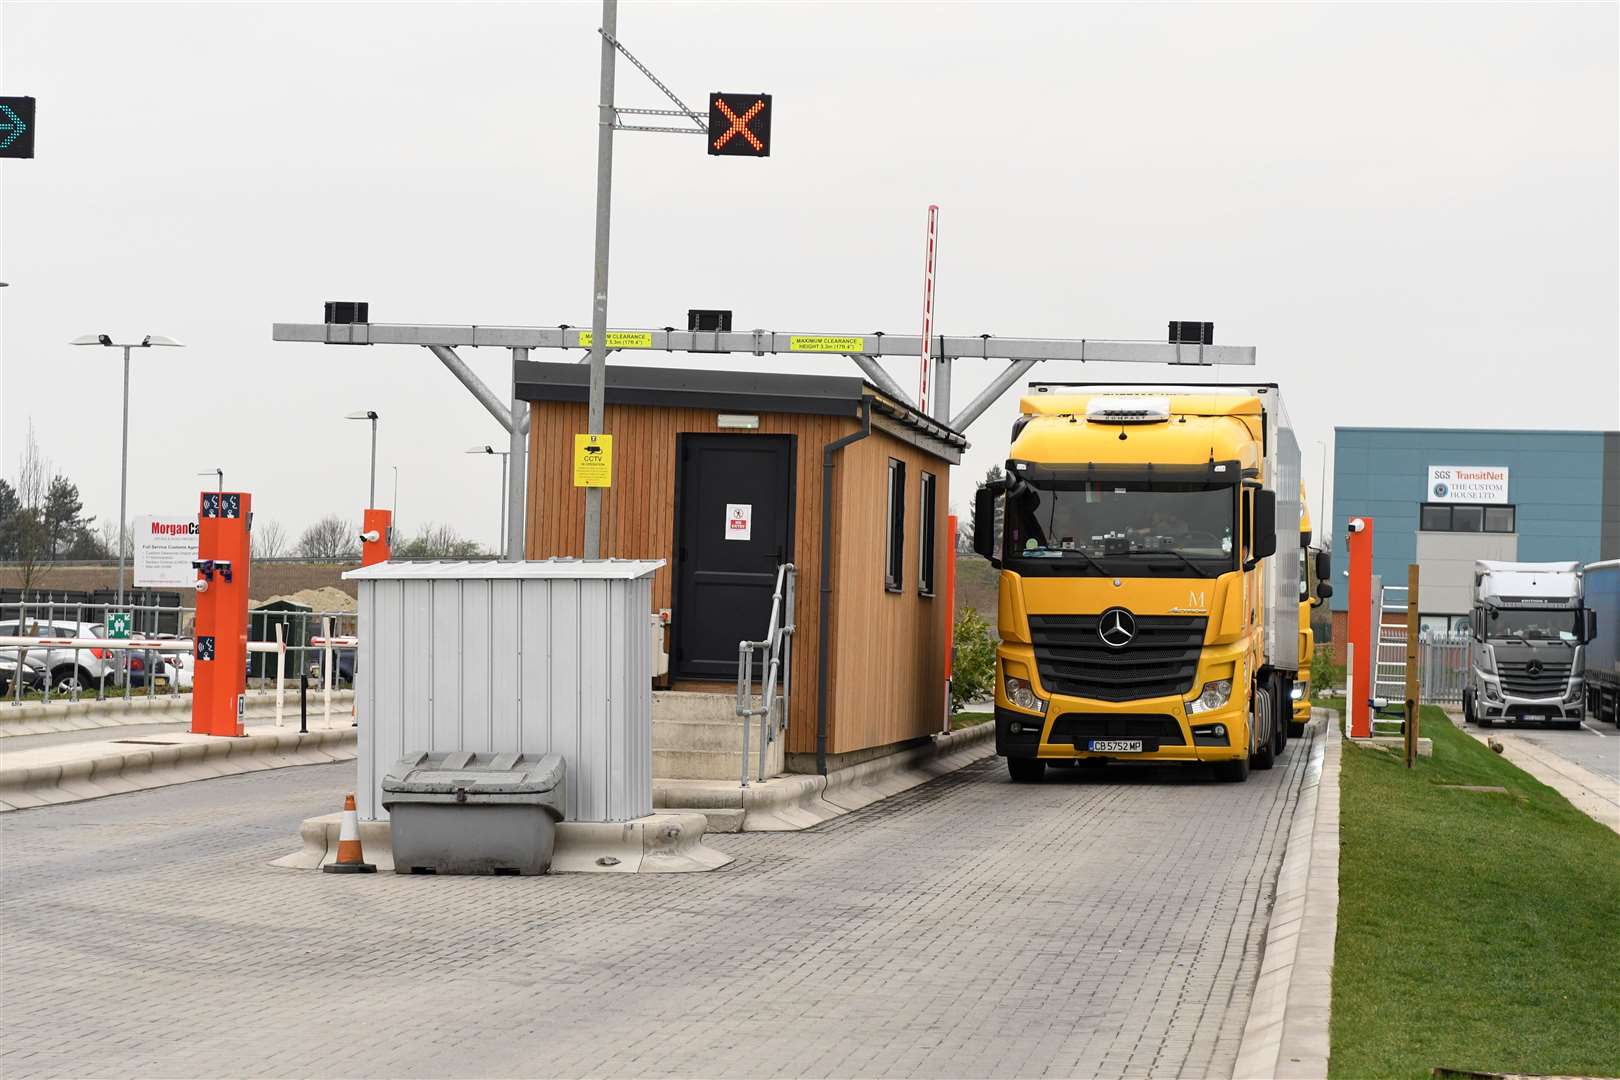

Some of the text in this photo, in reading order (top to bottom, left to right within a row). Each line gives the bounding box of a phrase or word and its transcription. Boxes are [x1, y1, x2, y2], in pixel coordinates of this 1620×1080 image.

[1434, 470, 1504, 480] SGS TransitNet
[1451, 483, 1503, 491] THE CUSTOM
[1094, 741, 1106, 751] CB
[1107, 741, 1129, 751] 5752
